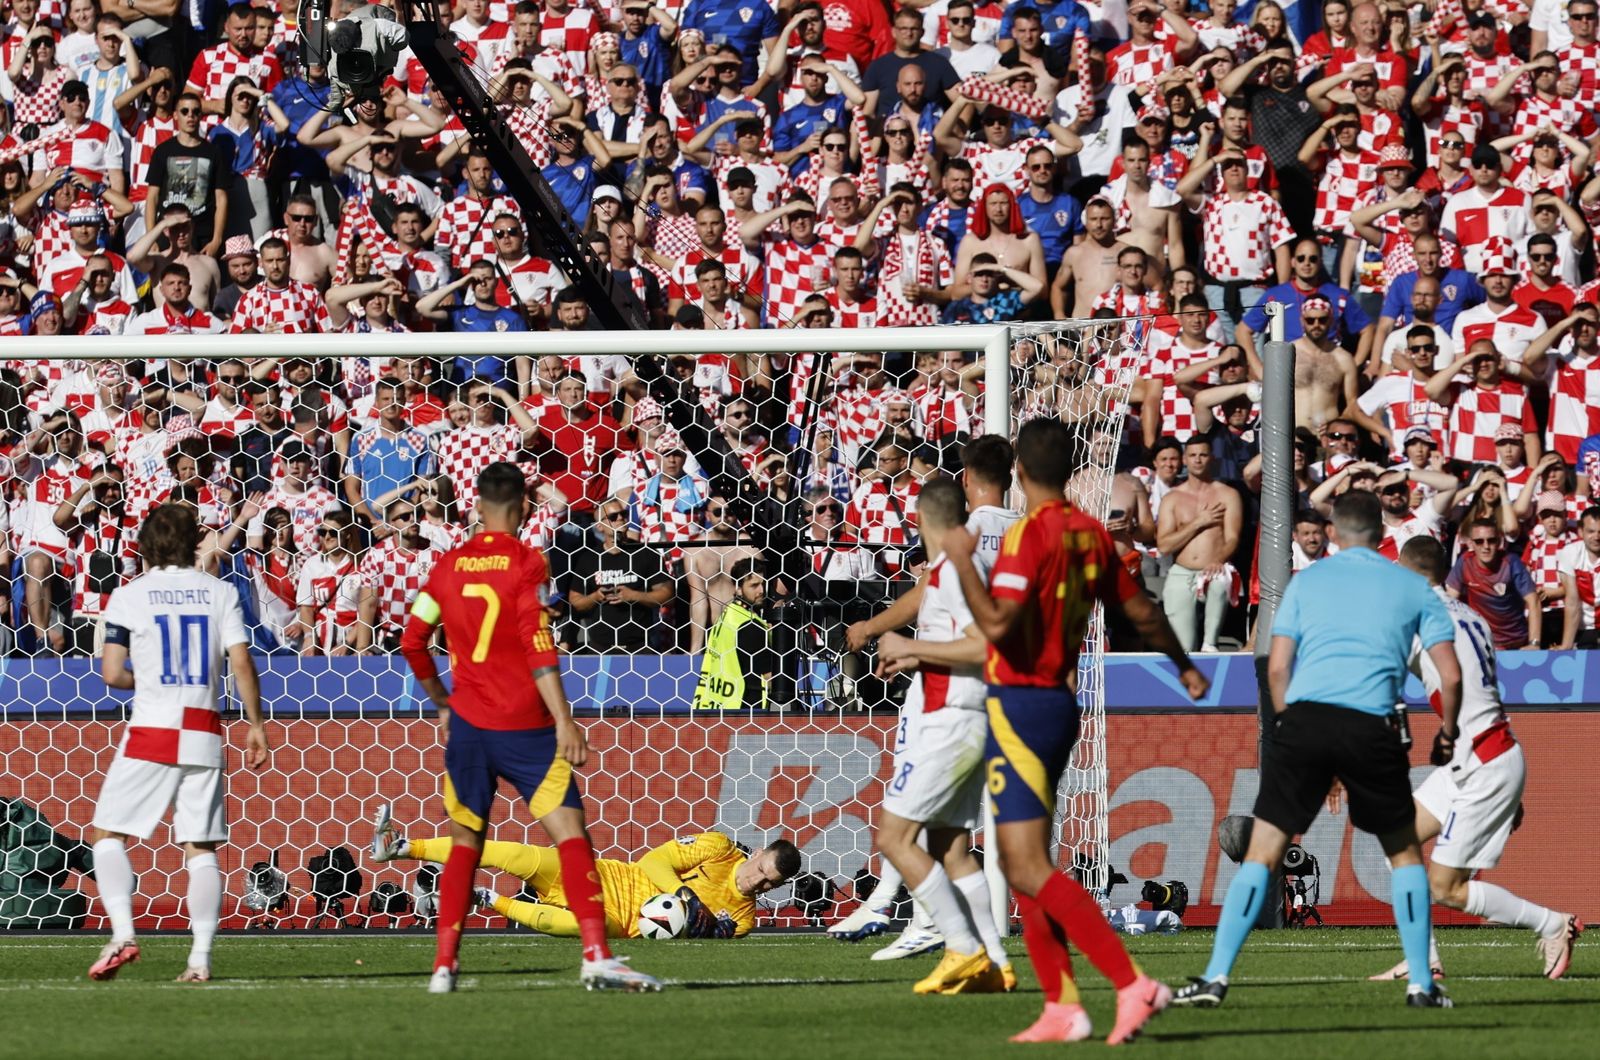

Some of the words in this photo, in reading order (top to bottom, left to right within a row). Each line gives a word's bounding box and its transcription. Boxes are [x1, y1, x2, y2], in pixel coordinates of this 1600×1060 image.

[454, 555, 510, 572] MORATA
[462, 583, 500, 663] 7
[153, 614, 209, 686] 10
[893, 761, 914, 792] 8
